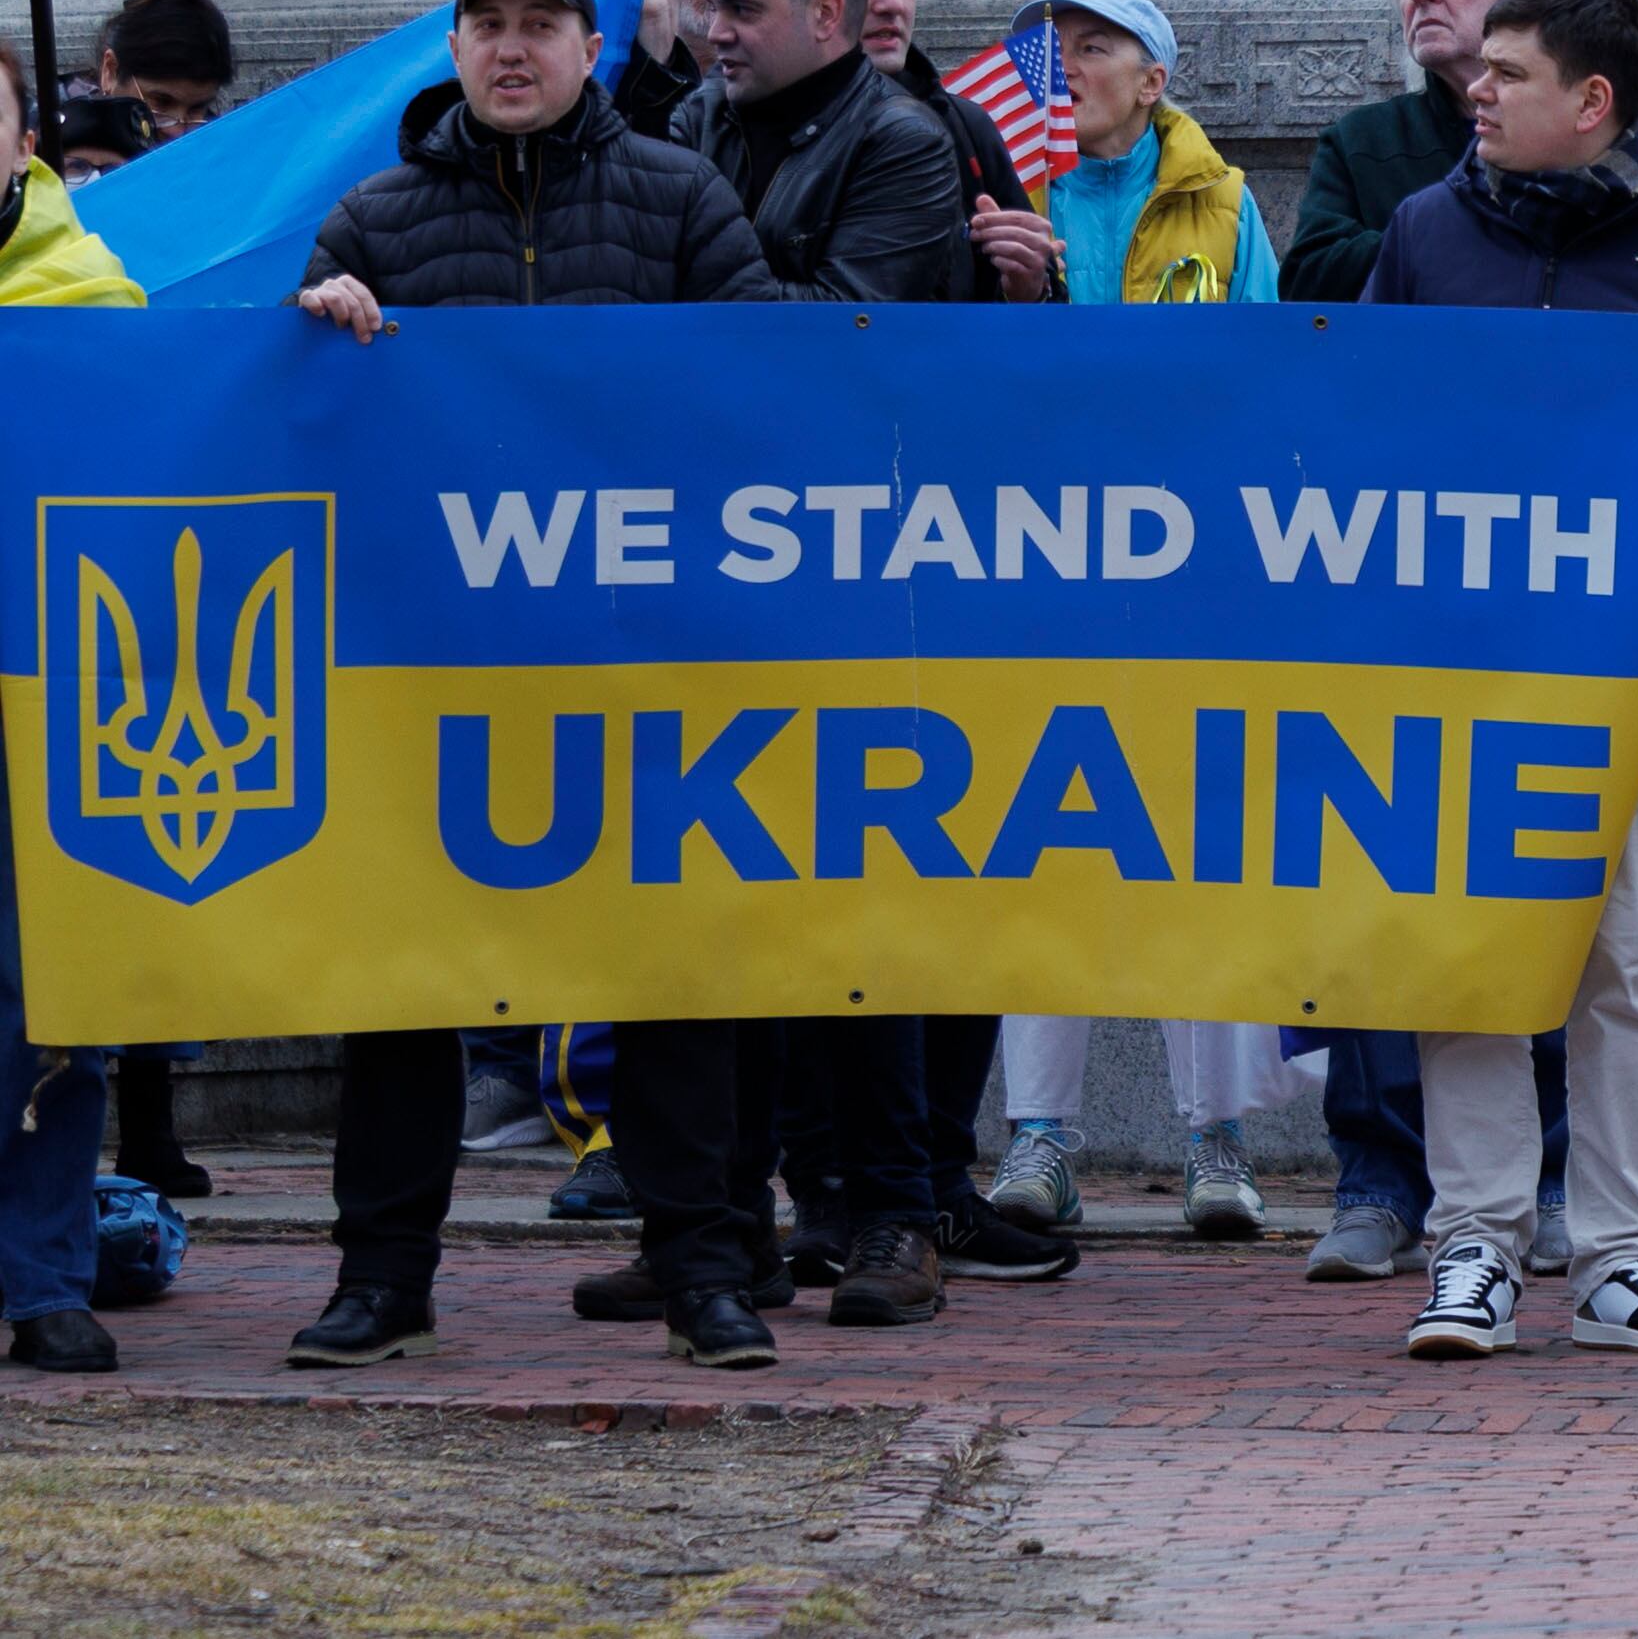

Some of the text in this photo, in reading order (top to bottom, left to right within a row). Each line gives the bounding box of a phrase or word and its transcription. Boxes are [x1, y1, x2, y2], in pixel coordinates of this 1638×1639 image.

[437, 484, 1618, 596] WE STAND WITH
[437, 705, 1611, 902] UKRAINE
